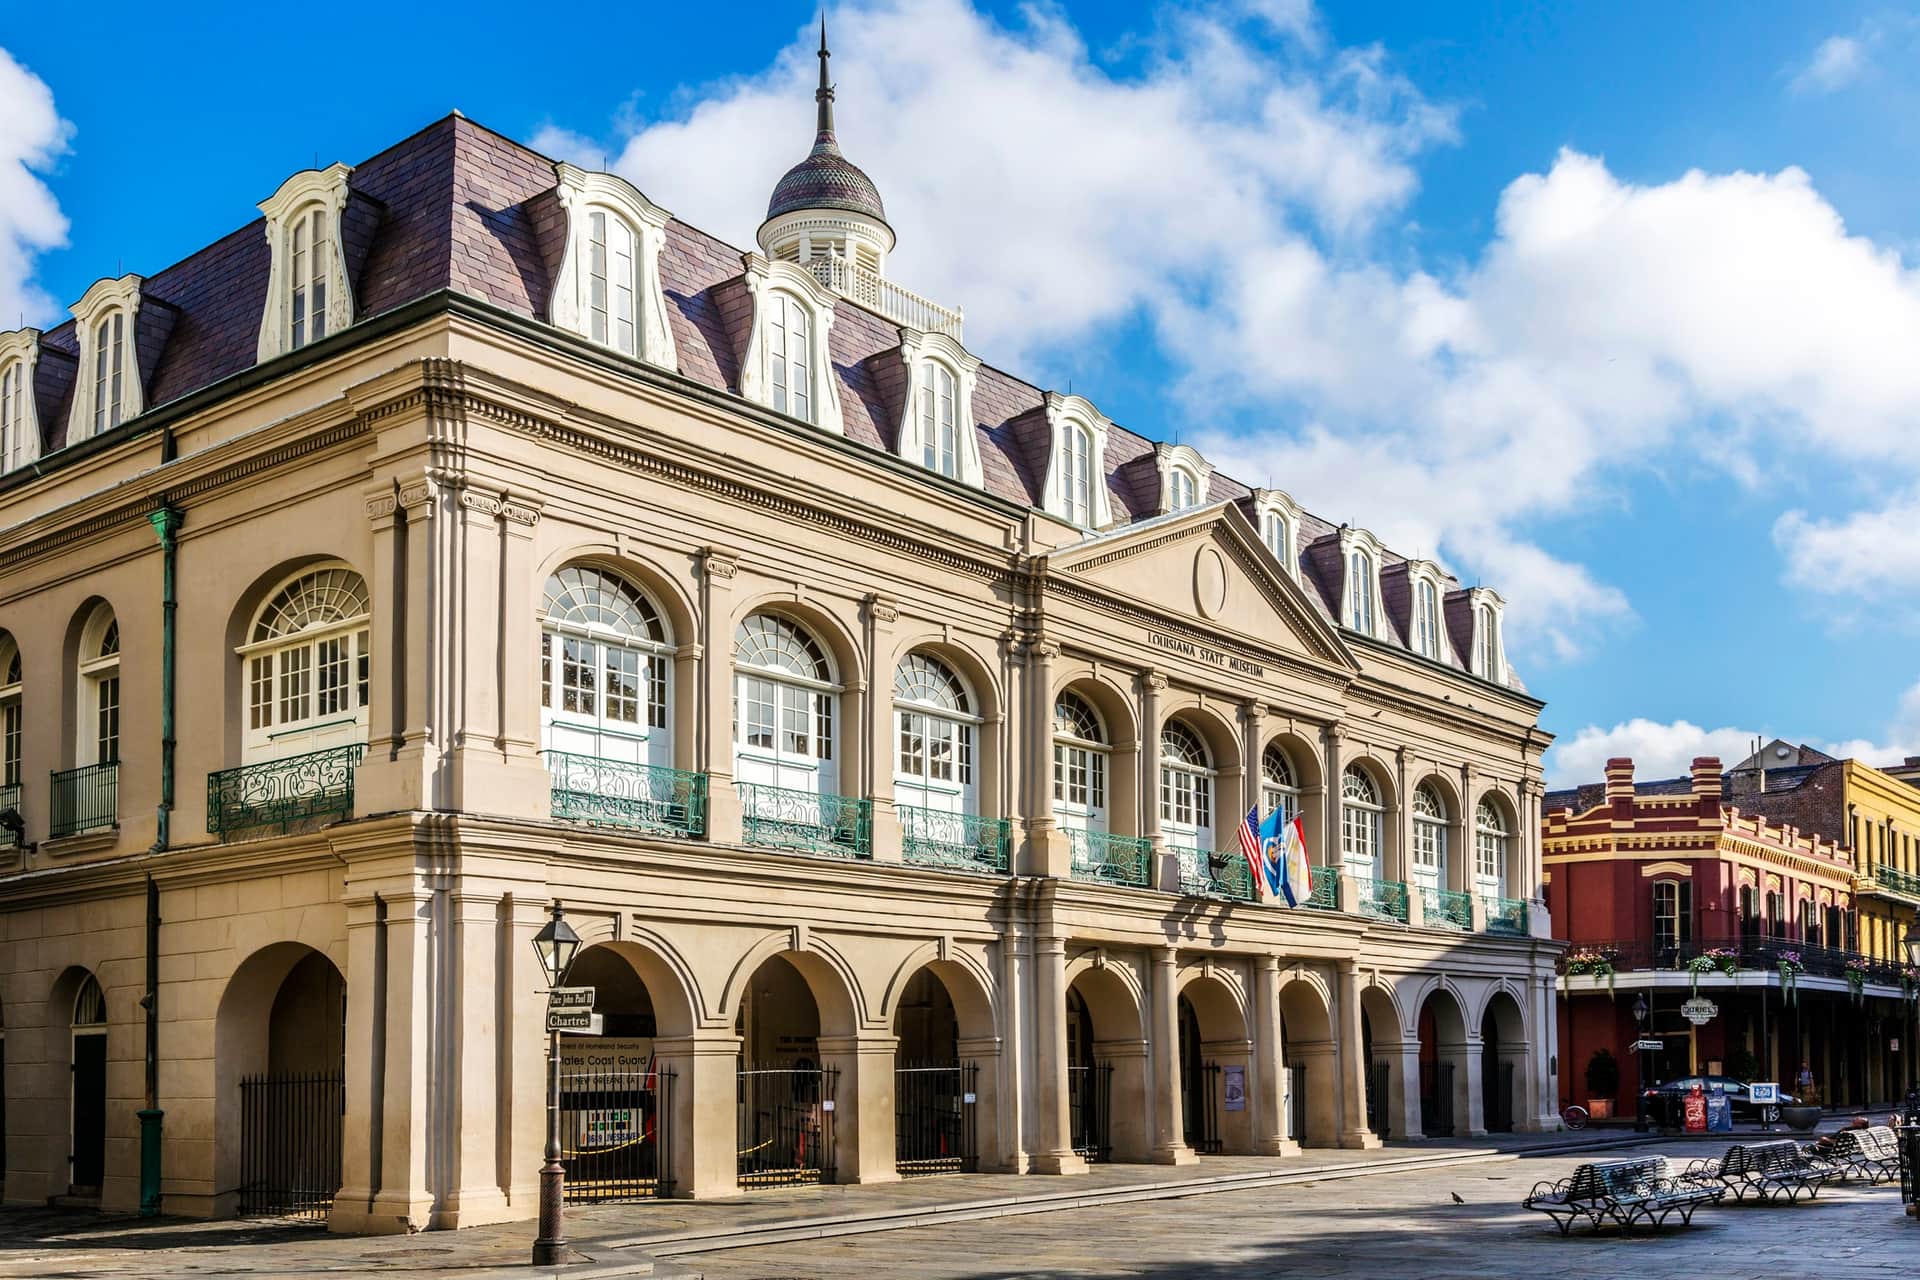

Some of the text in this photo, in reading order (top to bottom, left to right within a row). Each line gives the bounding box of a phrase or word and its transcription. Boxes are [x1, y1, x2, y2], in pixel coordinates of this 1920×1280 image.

[1148, 631, 1264, 678] LOUISIANA STATE MUSEUM
[561, 993, 574, 1006] John
[575, 993, 586, 1003] Paul
[550, 1015, 589, 1026] Chartres
[559, 1055, 647, 1065] tates Coast Guard
